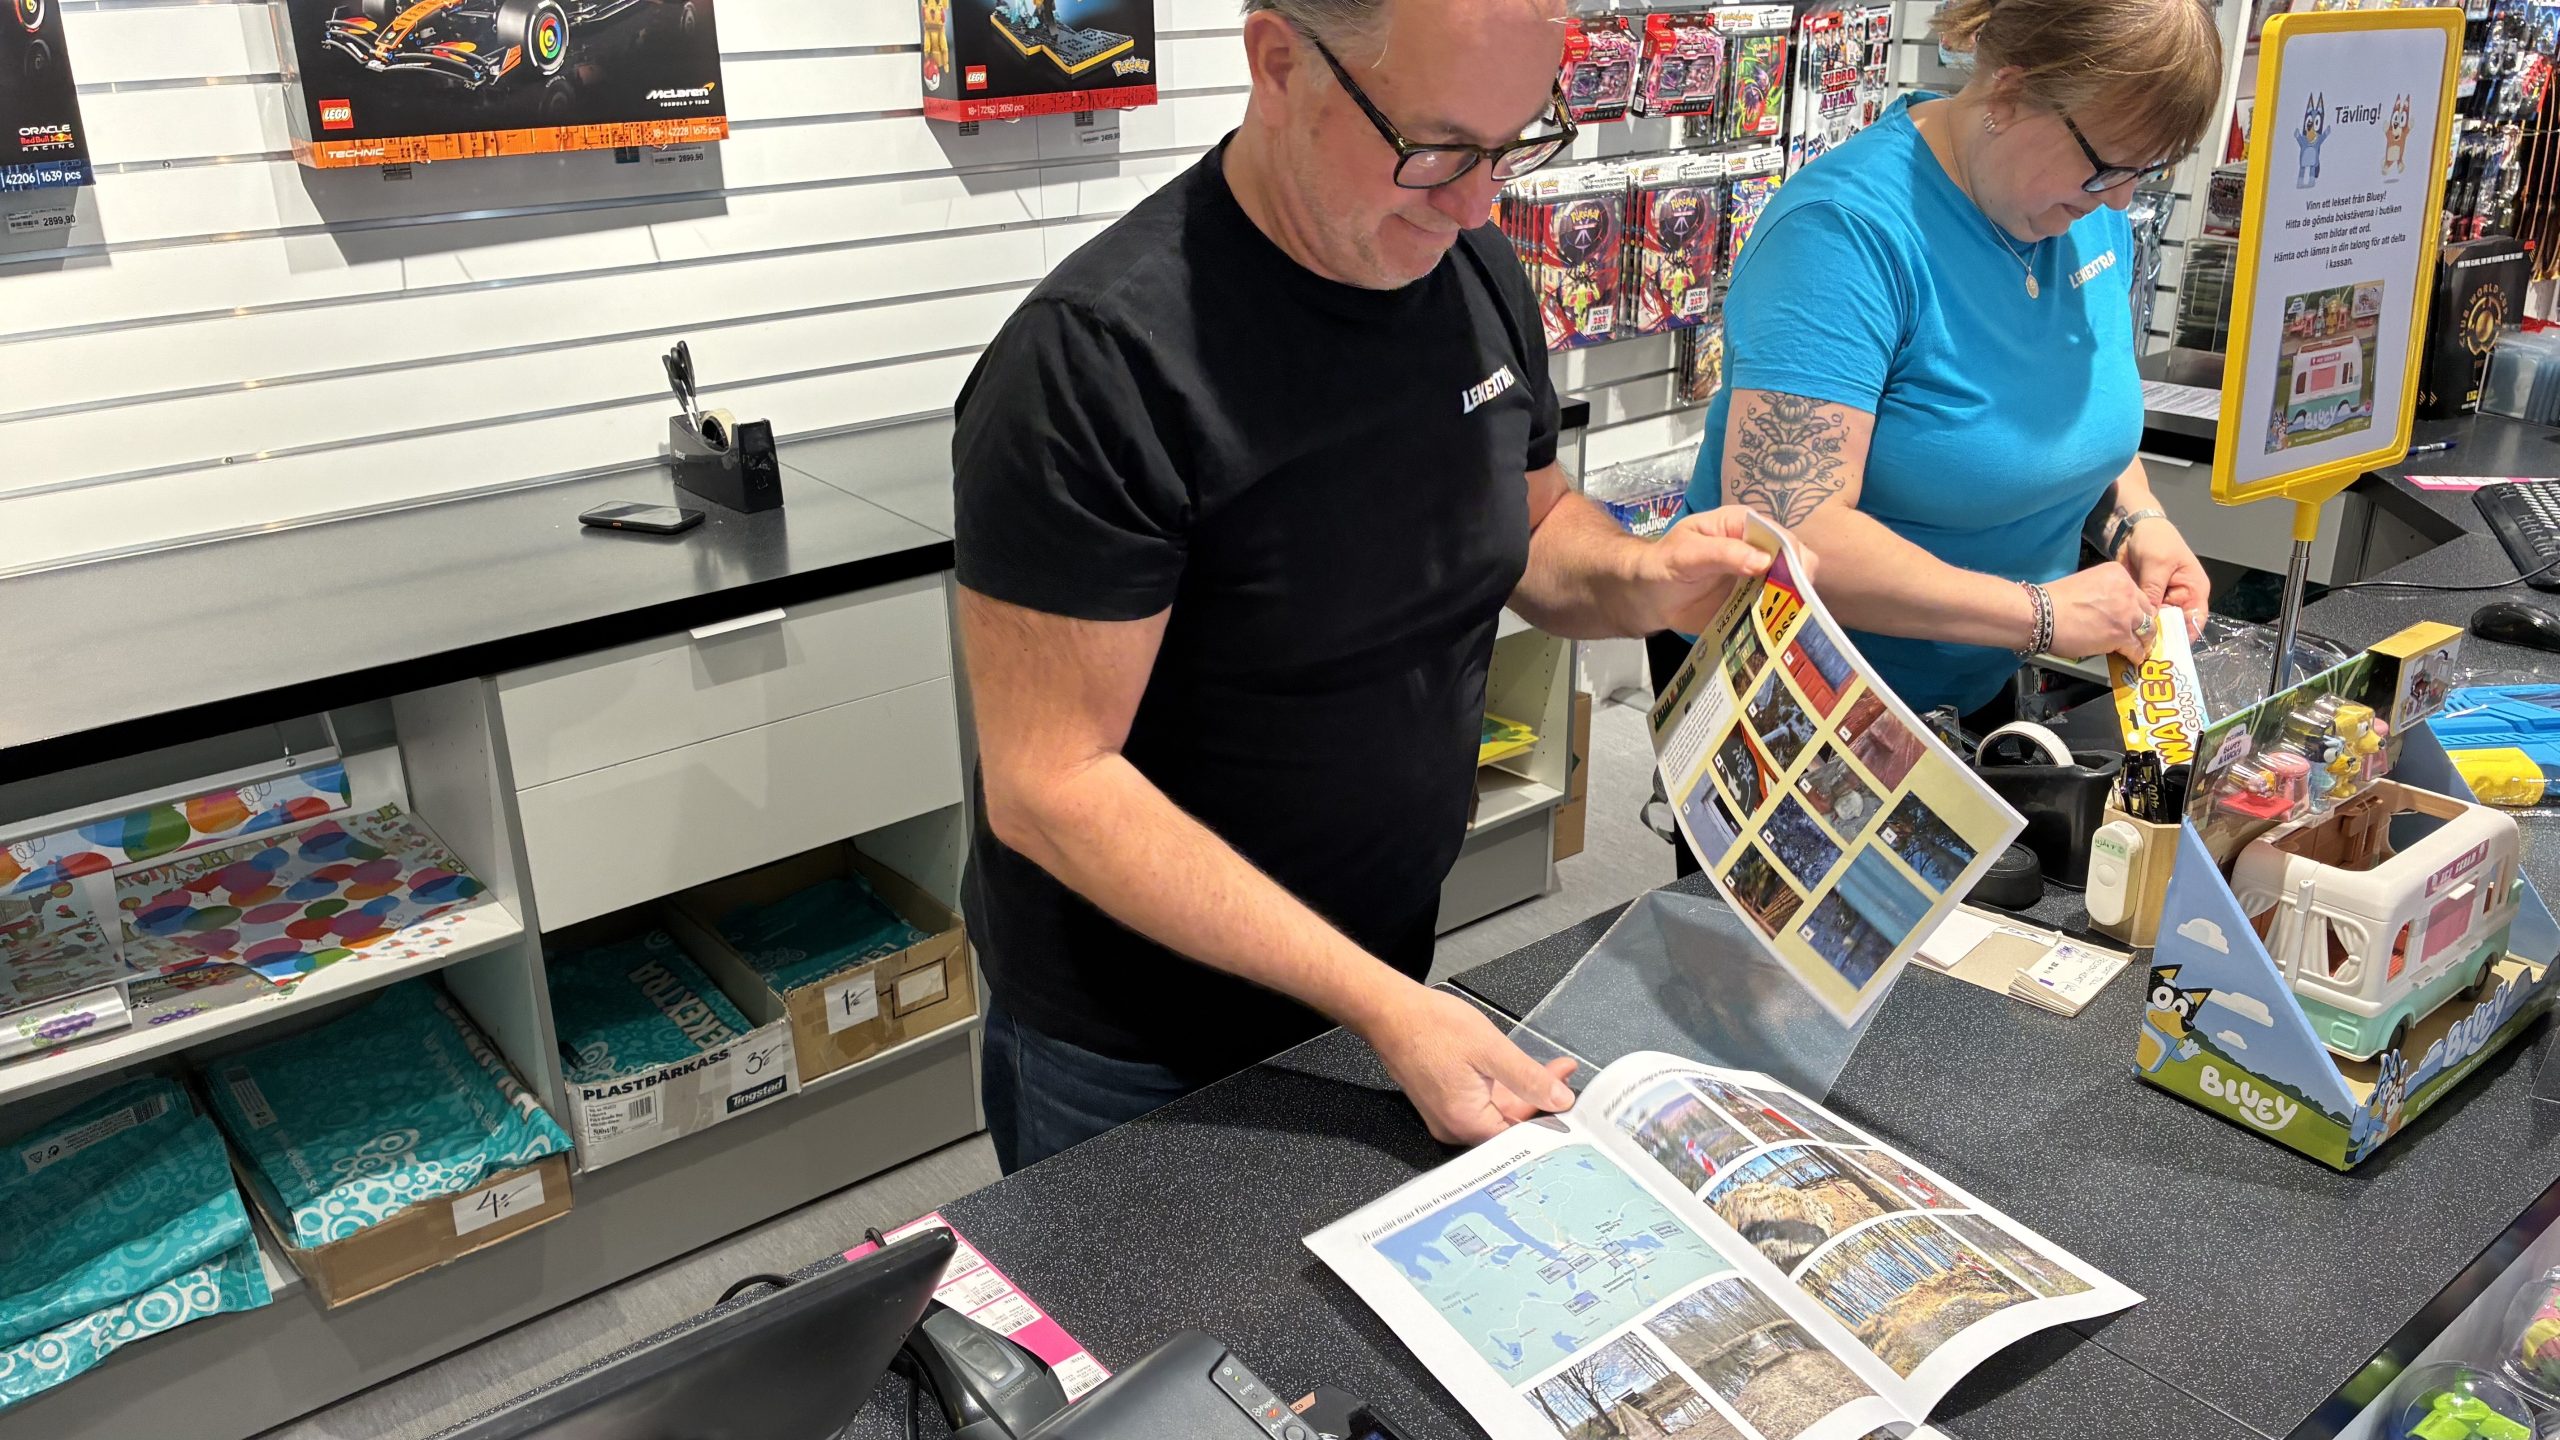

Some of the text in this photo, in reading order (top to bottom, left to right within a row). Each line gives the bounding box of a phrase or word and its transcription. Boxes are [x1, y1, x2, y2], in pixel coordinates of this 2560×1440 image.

[1112, 57, 1150, 77] Pokémon
[967, 71, 985, 83] LEGO
[646, 88, 709, 100] McLaren
[324, 107, 351, 121] LEGO
[1014, 104, 1025, 113] pcs
[2335, 103, 2382, 125] Tävling!
[18, 124, 71, 136] ORACLE
[668, 127, 688, 137] 42228
[708, 125, 720, 135] pcs
[20, 135, 50, 145] Red Bull
[22, 142, 75, 152] RACING
[328, 148, 384, 158] TECHNIC
[6, 170, 82, 185] 42206 1639 pcs
[1670, 194, 1698, 208] Pokémon
[2306, 190, 2387, 211] Vinn ett lekset från Bluey!
[42, 214, 76, 227] 2899,90
[2285, 218, 2301, 230] Hitta
[2302, 217, 2311, 227] de
[2311, 214, 2334, 228] gömda
[2335, 210, 2374, 223] bokstäverna
[2379, 204, 2402, 216] butiken
[2314, 223, 2372, 241] som bildar ett ord.
[2273, 232, 2406, 263] Hämta och lämna in din talong för att delta
[2068, 249, 2116, 289] LEKEXTRA
[2329, 257, 2354, 269] kassan.
[2458, 308, 2470, 349] CLUB
[2469, 282, 2499, 305] WORLD
[2140, 658, 2195, 766] WATER
[2177, 690, 2200, 733] GUN
[2442, 980, 2508, 1068] BLUEY
[583, 1048, 736, 1101] PLASTBÄRKASS
[732, 1080, 784, 1107] Tingstad
[2199, 1065, 2298, 1131] BLUEY
[1512, 1148, 1532, 1163] 2026
[1239, 1381, 1256, 1396] Error
[1258, 1396, 1278, 1411] Paper
[1278, 1411, 1294, 1428] Feed
